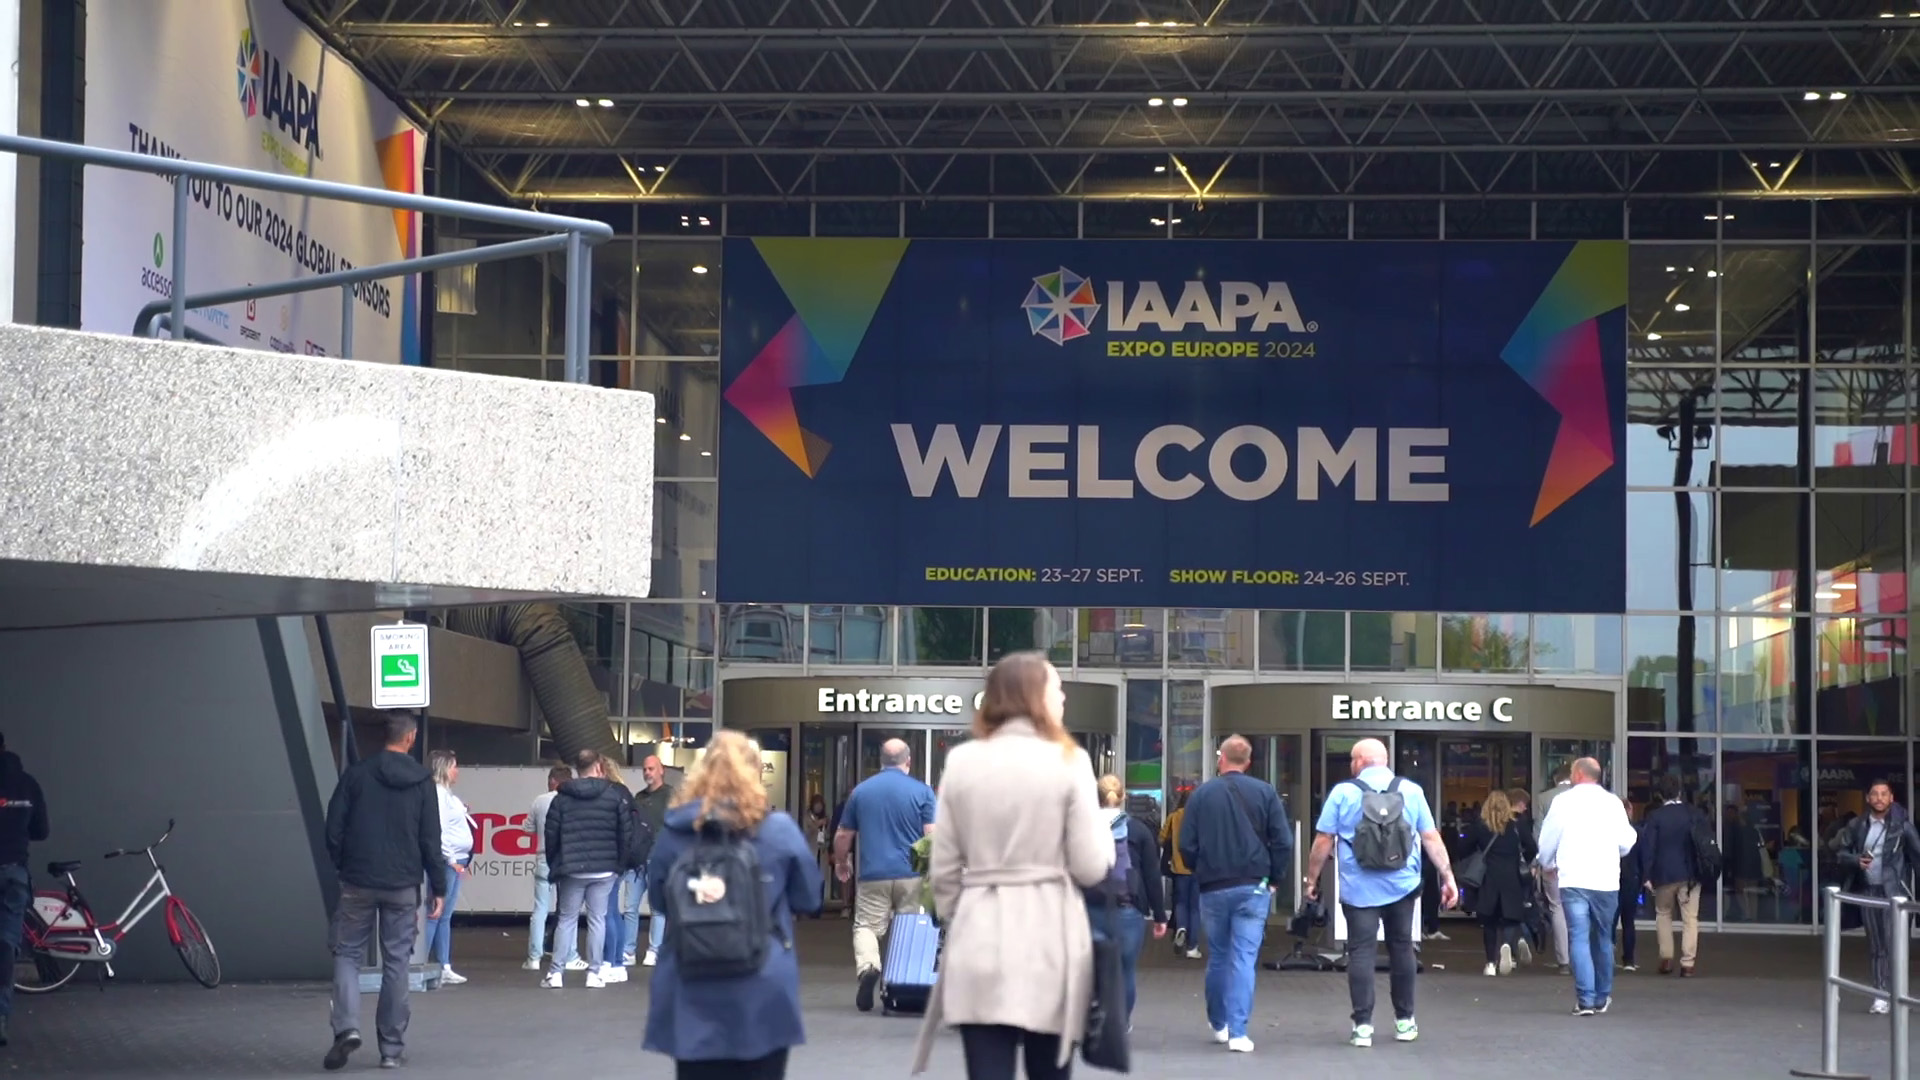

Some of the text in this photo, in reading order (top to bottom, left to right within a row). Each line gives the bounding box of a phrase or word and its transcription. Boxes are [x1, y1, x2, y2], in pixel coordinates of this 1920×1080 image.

[263, 49, 321, 159] IAAPA
[215, 180, 233, 221] TO
[236, 193, 262, 238] OUR
[265, 208, 293, 257] 2024
[340, 257, 391, 318] NSORS
[141, 267, 173, 299] accesso
[1106, 341, 1316, 358] EXPO EUROPE 2024
[890, 423, 1450, 502] WELCOME
[925, 567, 1036, 582] EDUCATION:
[1096, 568, 1144, 583] SEPT.
[1169, 569, 1227, 583] SHOW
[1232, 570, 1300, 584] FLOOR:
[1362, 571, 1410, 586] SEPT.
[380, 633, 420, 641] SMOKING
[818, 687, 963, 714] Entrance
[1332, 694, 1513, 722] Entrance C
[1818, 768, 1856, 781] AAPA
[468, 860, 537, 876] MSTER
